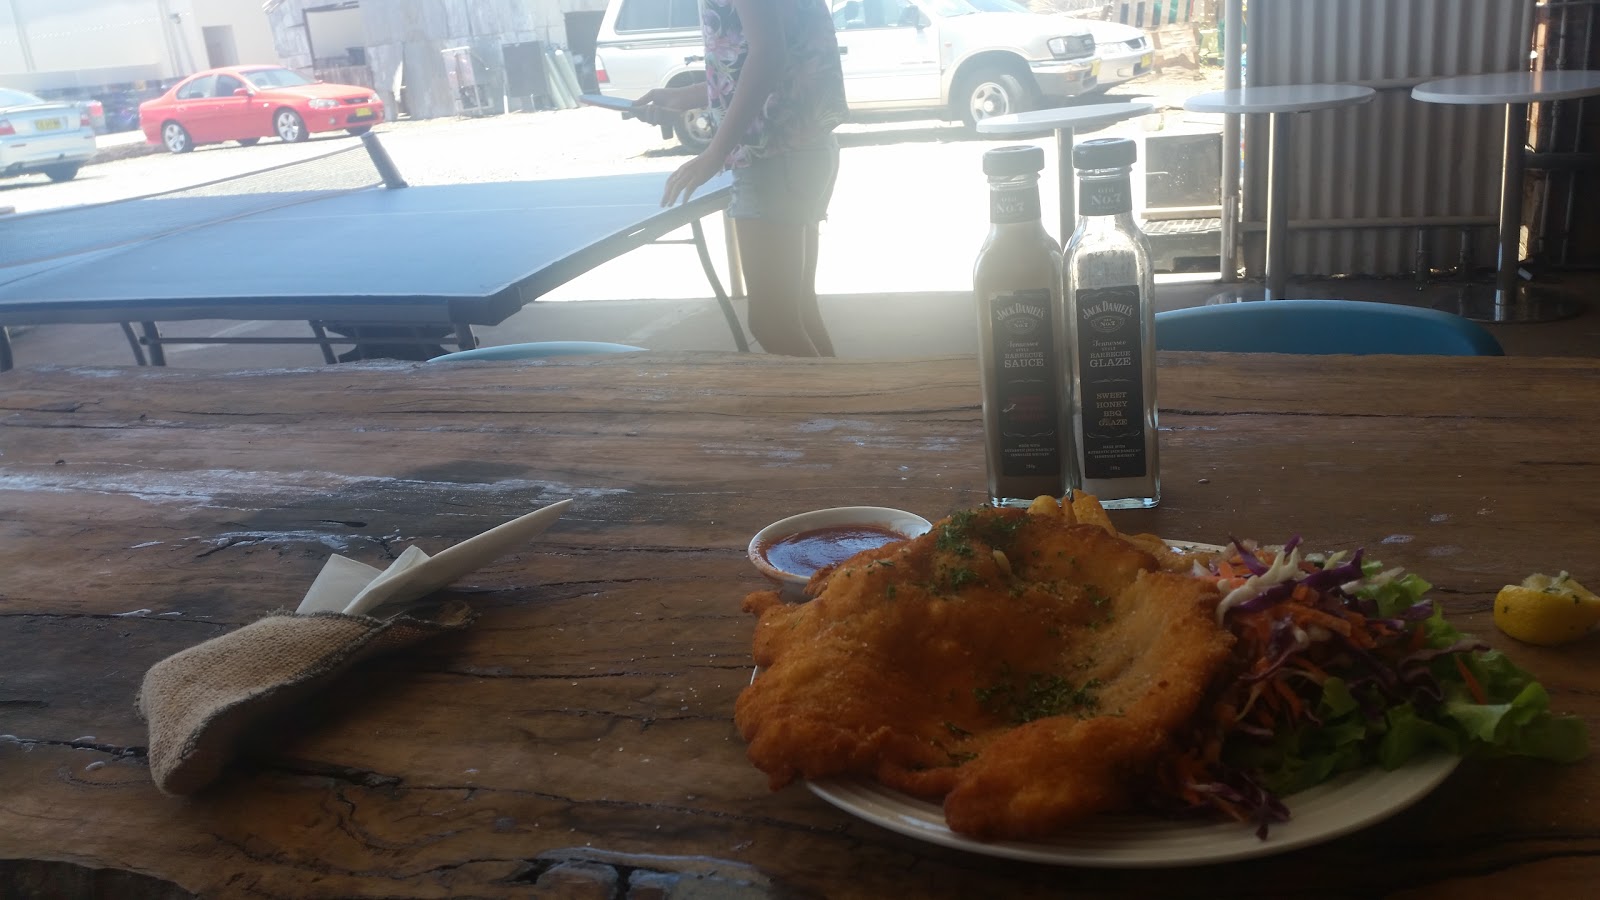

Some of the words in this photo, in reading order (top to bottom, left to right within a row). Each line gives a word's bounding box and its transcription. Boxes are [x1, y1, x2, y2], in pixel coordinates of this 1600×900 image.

[1091, 192, 1121, 205] No.7
[996, 202, 1025, 213] No.7
[996, 305, 1016, 321] JACK
[1082, 304, 1103, 319] JACK
[1102, 301, 1133, 318] DANIEL'S
[1090, 350, 1131, 359] BARBECUE
[1004, 358, 1044, 369] SAUCE
[1089, 357, 1131, 368] GLAZE
[1096, 391, 1128, 400] SWEET
[1096, 401, 1128, 409] HONEY
